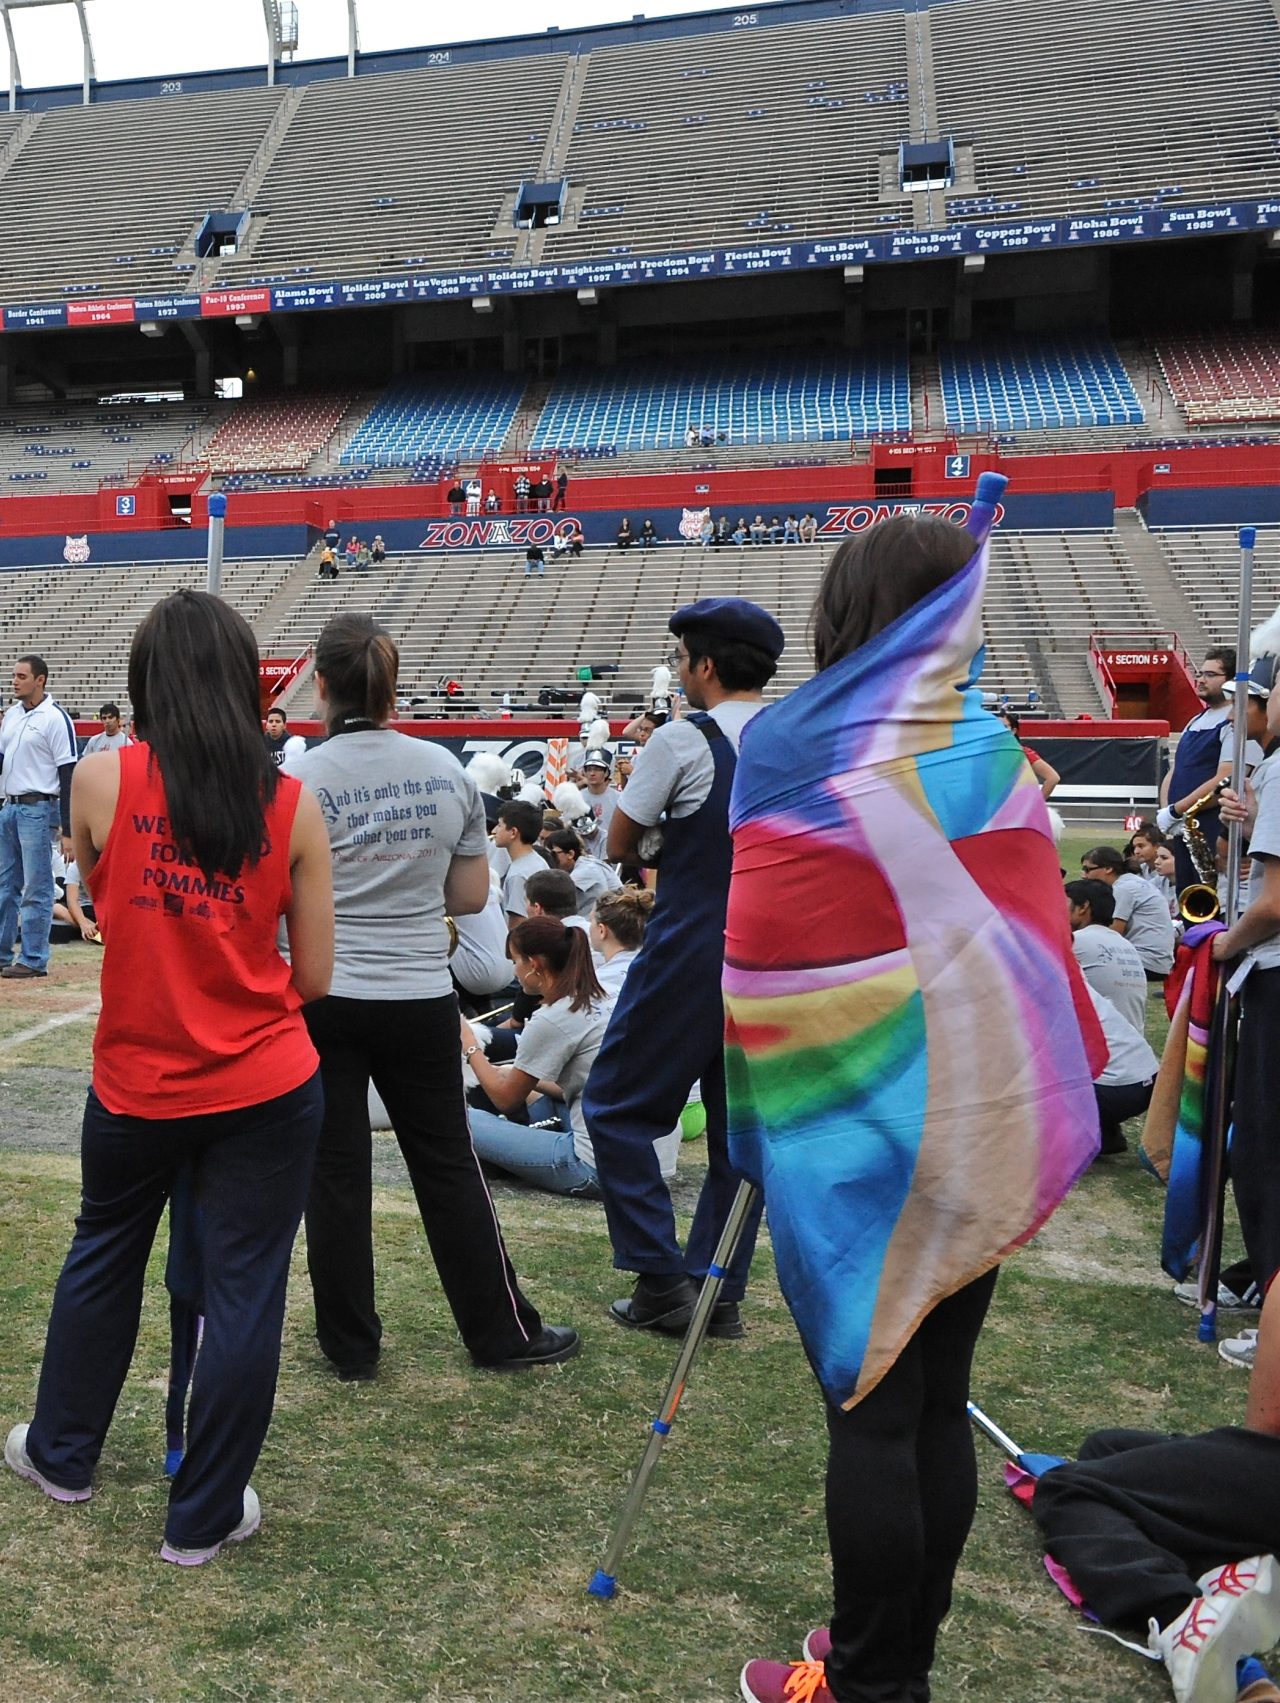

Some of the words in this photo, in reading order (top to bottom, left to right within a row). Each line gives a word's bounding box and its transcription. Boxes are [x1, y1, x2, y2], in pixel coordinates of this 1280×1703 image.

[734, 14, 757, 26] 205
[429, 51, 450, 63] 204
[162, 81, 182, 92] 203
[1169, 212, 1195, 221] Sun
[1197, 207, 1231, 219] Bowl
[1070, 220, 1107, 230] Aloha
[1110, 216, 1143, 226] Bowl
[1186, 220, 1214, 230] 1985
[975, 228, 1022, 239] Copper
[1023, 223, 1056, 234] Bowl
[1093, 229, 1120, 238] 1986
[892, 236, 928, 246] Aloha
[930, 232, 961, 242] Bowl
[1002, 237, 1028, 246] 1989
[814, 244, 837, 253] Sun
[838, 240, 869, 250] Bowl
[914, 245, 940, 254] 1990
[724, 251, 760, 260] Fiesta
[761, 247, 792, 257] Bowl
[829, 253, 854, 261] 1992
[640, 259, 686, 269] Freedom
[688, 255, 715, 264] Bowl
[746, 260, 770, 269] 1994
[561, 265, 614, 276] Insight.com
[615, 261, 637, 270] Bowl
[666, 267, 689, 276] 1994
[487, 271, 529, 281] Holiday
[530, 268, 558, 277] Bowl
[588, 274, 610, 282] 1997
[413, 279, 429, 287] Las
[430, 278, 458, 287] Vegas
[459, 275, 483, 284] Bowl
[512, 280, 534, 288] 1998
[275, 290, 307, 298] Alamo
[308, 286, 334, 295] Bowl
[342, 284, 381, 293] Holiday
[382, 281, 409, 289] Bowl
[437, 287, 459, 295] 2008
[205, 295, 227, 304] Pac-10
[228, 293, 265, 302] Conference
[365, 292, 386, 300] 2009
[106, 302, 133, 310] Conference
[153, 299, 173, 307] Athletic
[173, 298, 200, 306] Conference
[294, 298, 315, 306] 2010
[8, 309, 28, 318] Border
[28, 308, 62, 317] Conference
[26, 317, 45, 325] 1941
[951, 457, 963, 470] 4
[121, 497, 130, 508] 3
[419, 517, 582, 548] ZONAZOO
[1106, 655, 1113, 664] 4
[1115, 655, 1150, 664] SECTION
[1152, 655, 1158, 664] 5
[265, 666, 291, 675] SECTION
[293, 666, 298, 675] 4
[317, 787, 351, 824] And
[353, 786, 370, 804] it's
[374, 782, 401, 800] only
[403, 779, 422, 797] the
[424, 776, 456, 795] giving
[347, 812, 370, 829] that
[373, 805, 412, 823] makes
[415, 803, 437, 819] you
[1126, 817, 1142, 830] 40
[352, 831, 382, 845] what
[385, 829, 407, 844] you
[410, 827, 434, 840] are.
[417, 848, 438, 859] 2011
[143, 867, 245, 904] POMMIES
